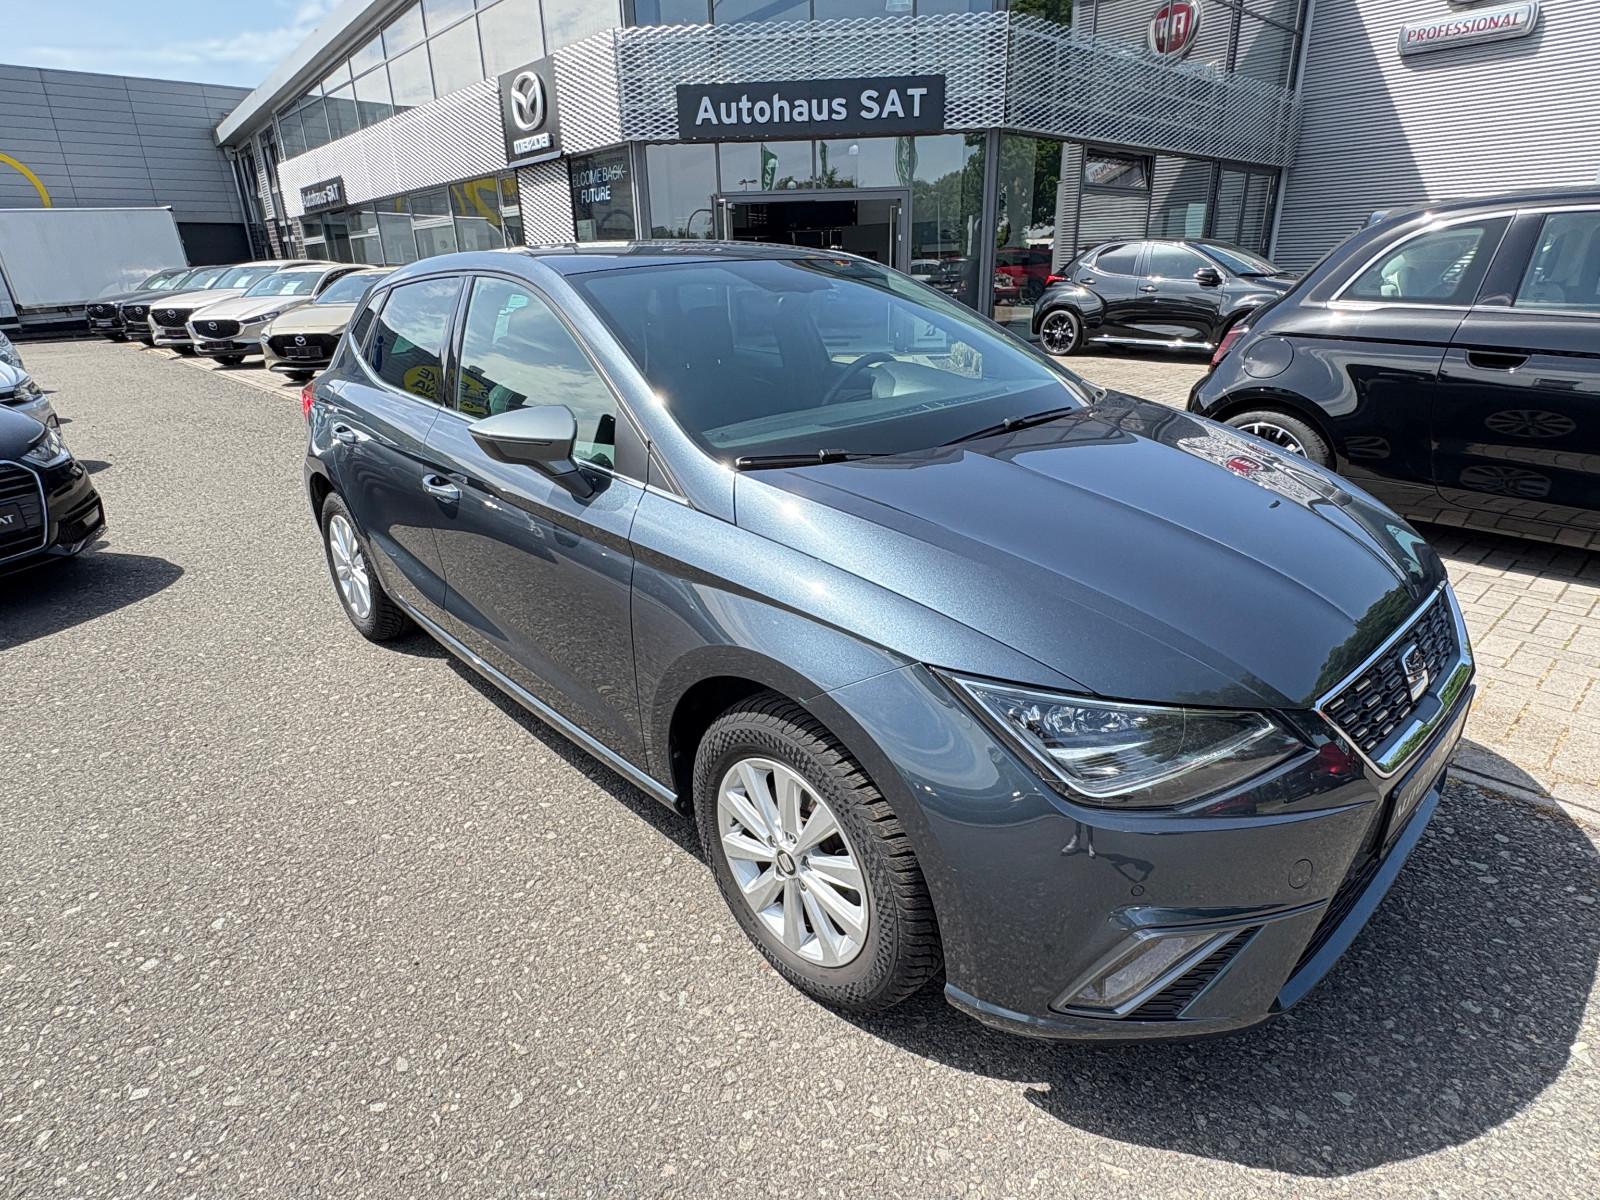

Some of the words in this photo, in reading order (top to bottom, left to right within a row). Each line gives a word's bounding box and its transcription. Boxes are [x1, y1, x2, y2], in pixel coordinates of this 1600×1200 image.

[1407, 12, 1520, 42] PROFESSIONAL
[696, 93, 848, 125] Autohaus
[860, 88, 928, 119] SAT
[572, 168, 603, 188] ELCOME
[581, 185, 611, 204] FUTURE
